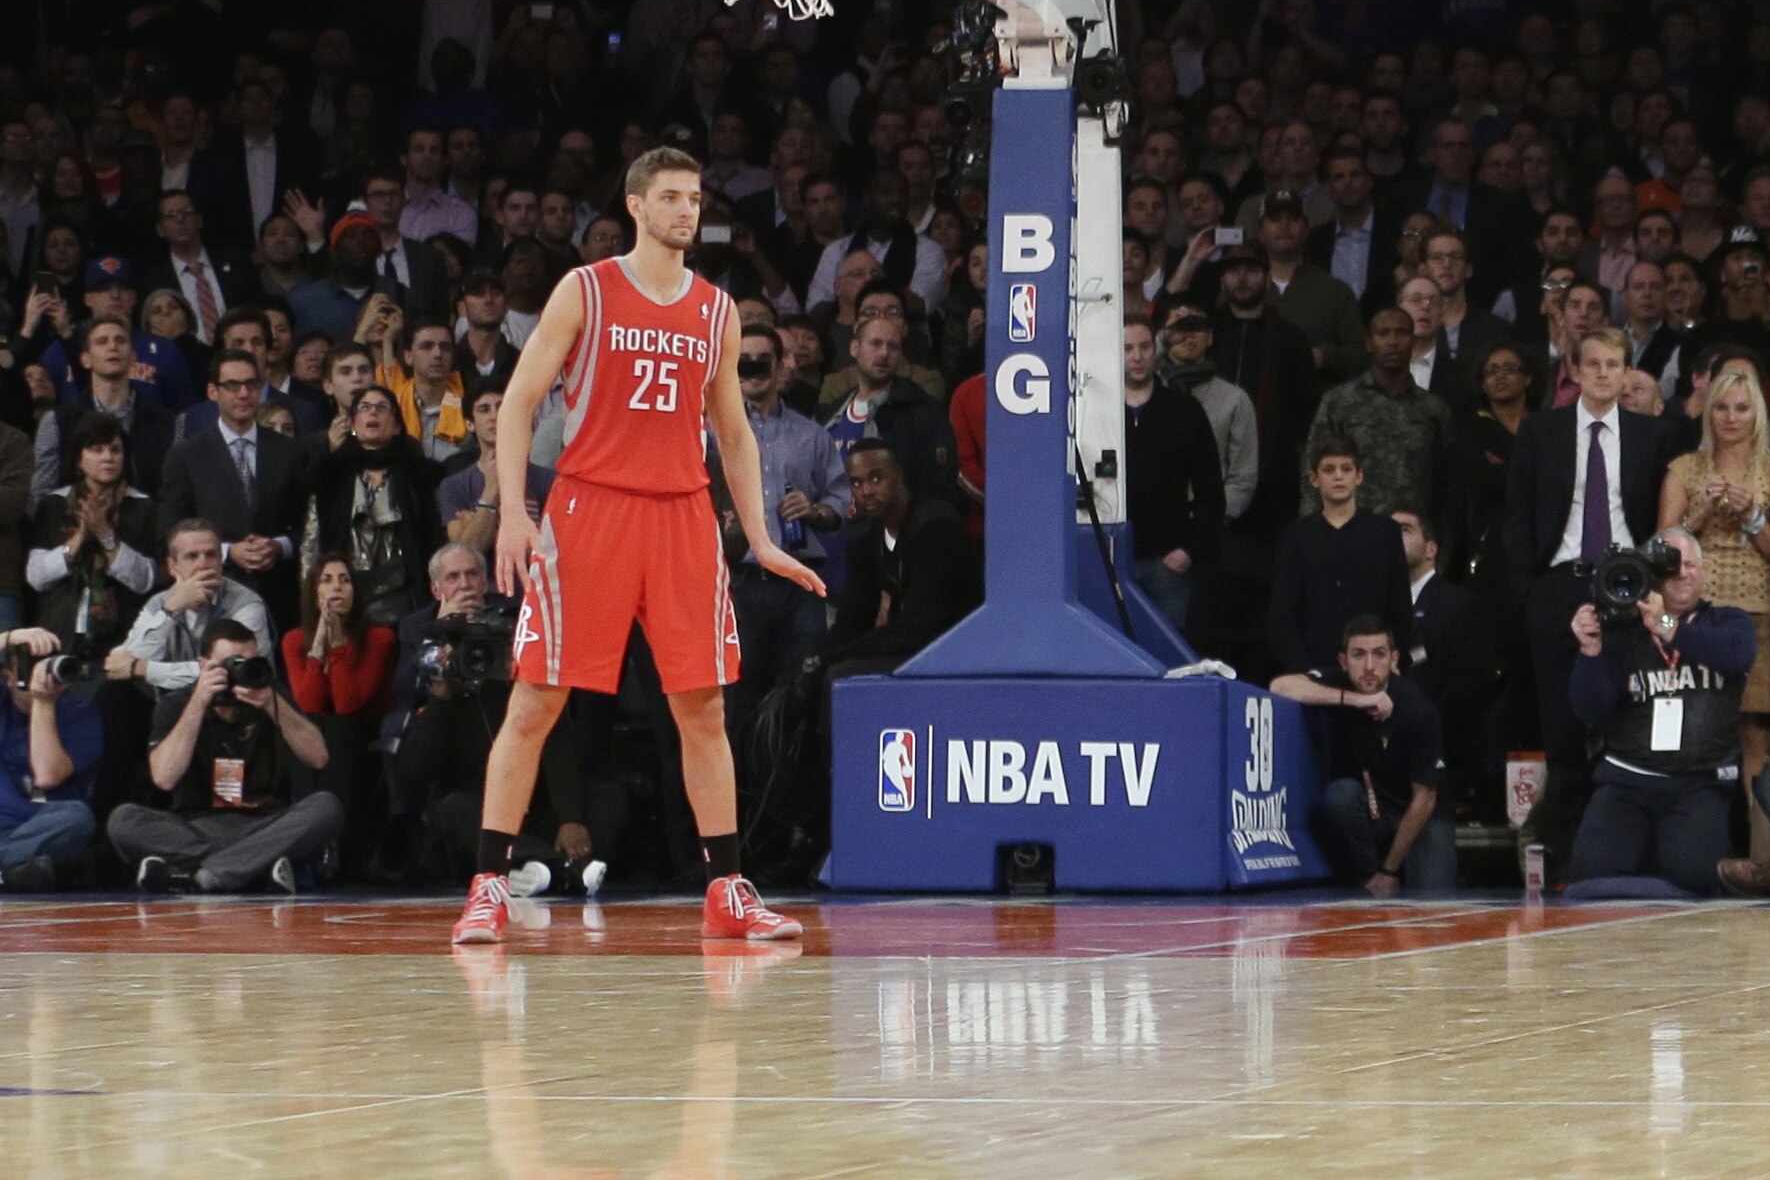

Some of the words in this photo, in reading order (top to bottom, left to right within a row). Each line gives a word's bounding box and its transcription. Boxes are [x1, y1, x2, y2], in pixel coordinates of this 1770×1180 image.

[607, 323, 708, 364] ROCKETS
[628, 358, 679, 412] 25
[1646, 664, 1696, 697] NBA
[946, 739, 1069, 806] NBA
[1079, 741, 1161, 808] TV
